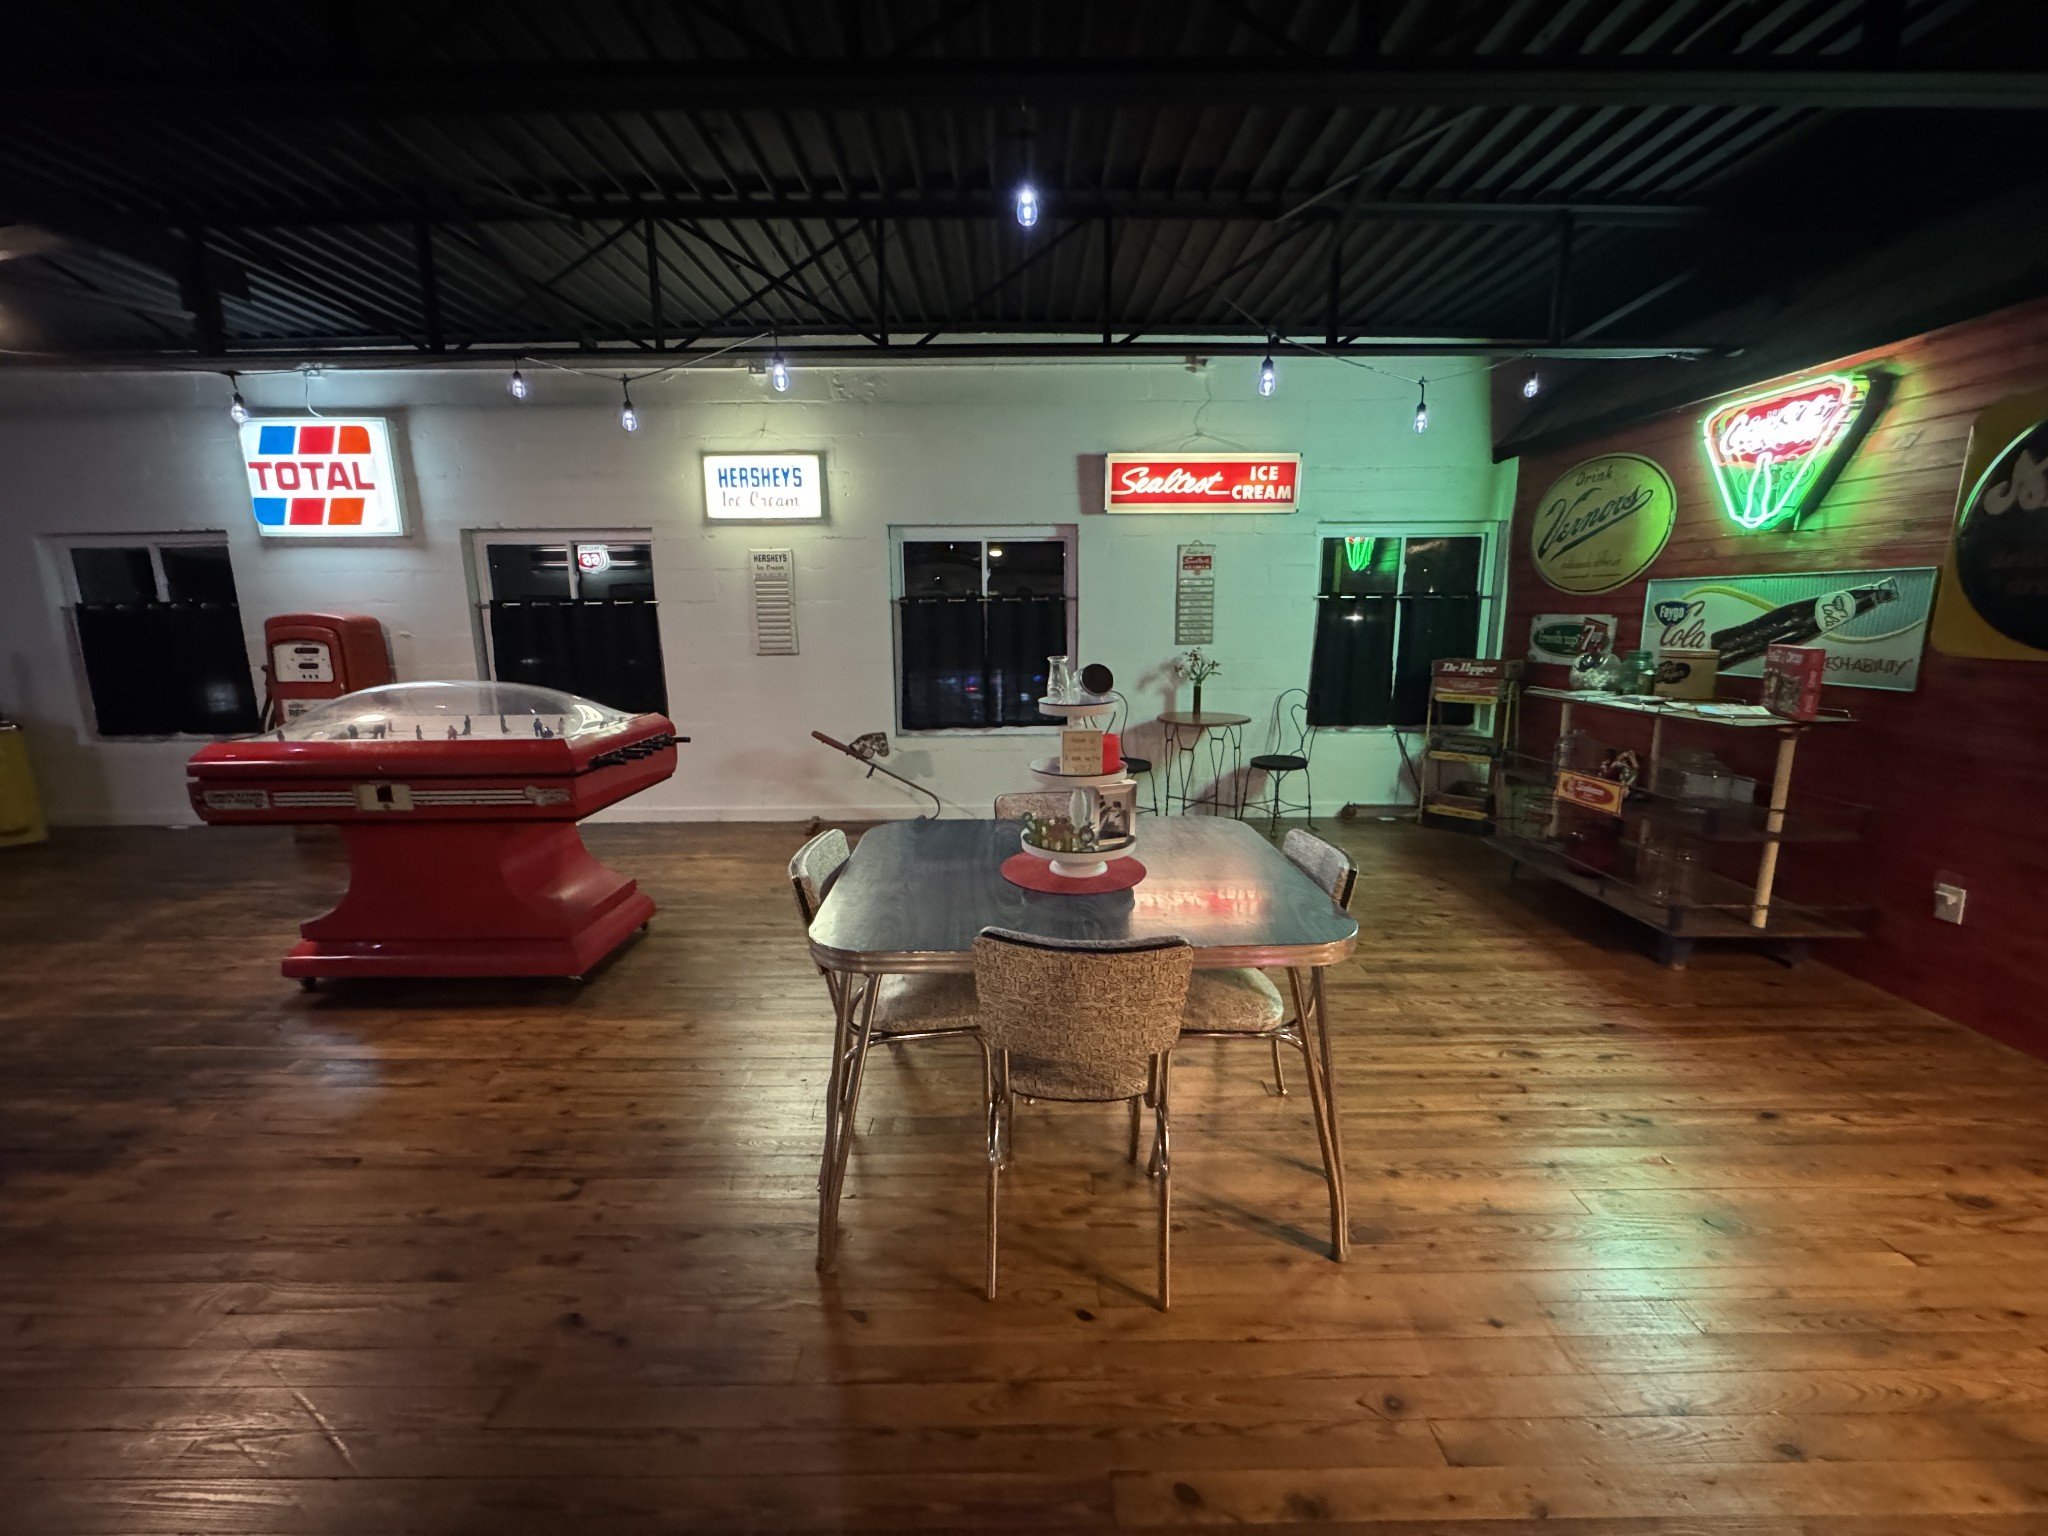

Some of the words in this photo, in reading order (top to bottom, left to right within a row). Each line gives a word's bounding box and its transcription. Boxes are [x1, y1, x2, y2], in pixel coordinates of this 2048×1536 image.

[248, 461, 376, 490] TOTAL
[718, 466, 802, 488] HERSHEY'S
[1112, 466, 1230, 495] Sealtest
[1250, 465, 1279, 481] ICE
[1575, 465, 1614, 486] Drink
[722, 490, 741, 507] Ice
[750, 490, 800, 507] Cream
[1231, 485, 1292, 500] CREAM
[1538, 485, 1653, 561] Vernors
[1660, 606, 1685, 621] Faygo
[1660, 600, 1706, 648] Cola
[1441, 662, 1458, 672] Dr
